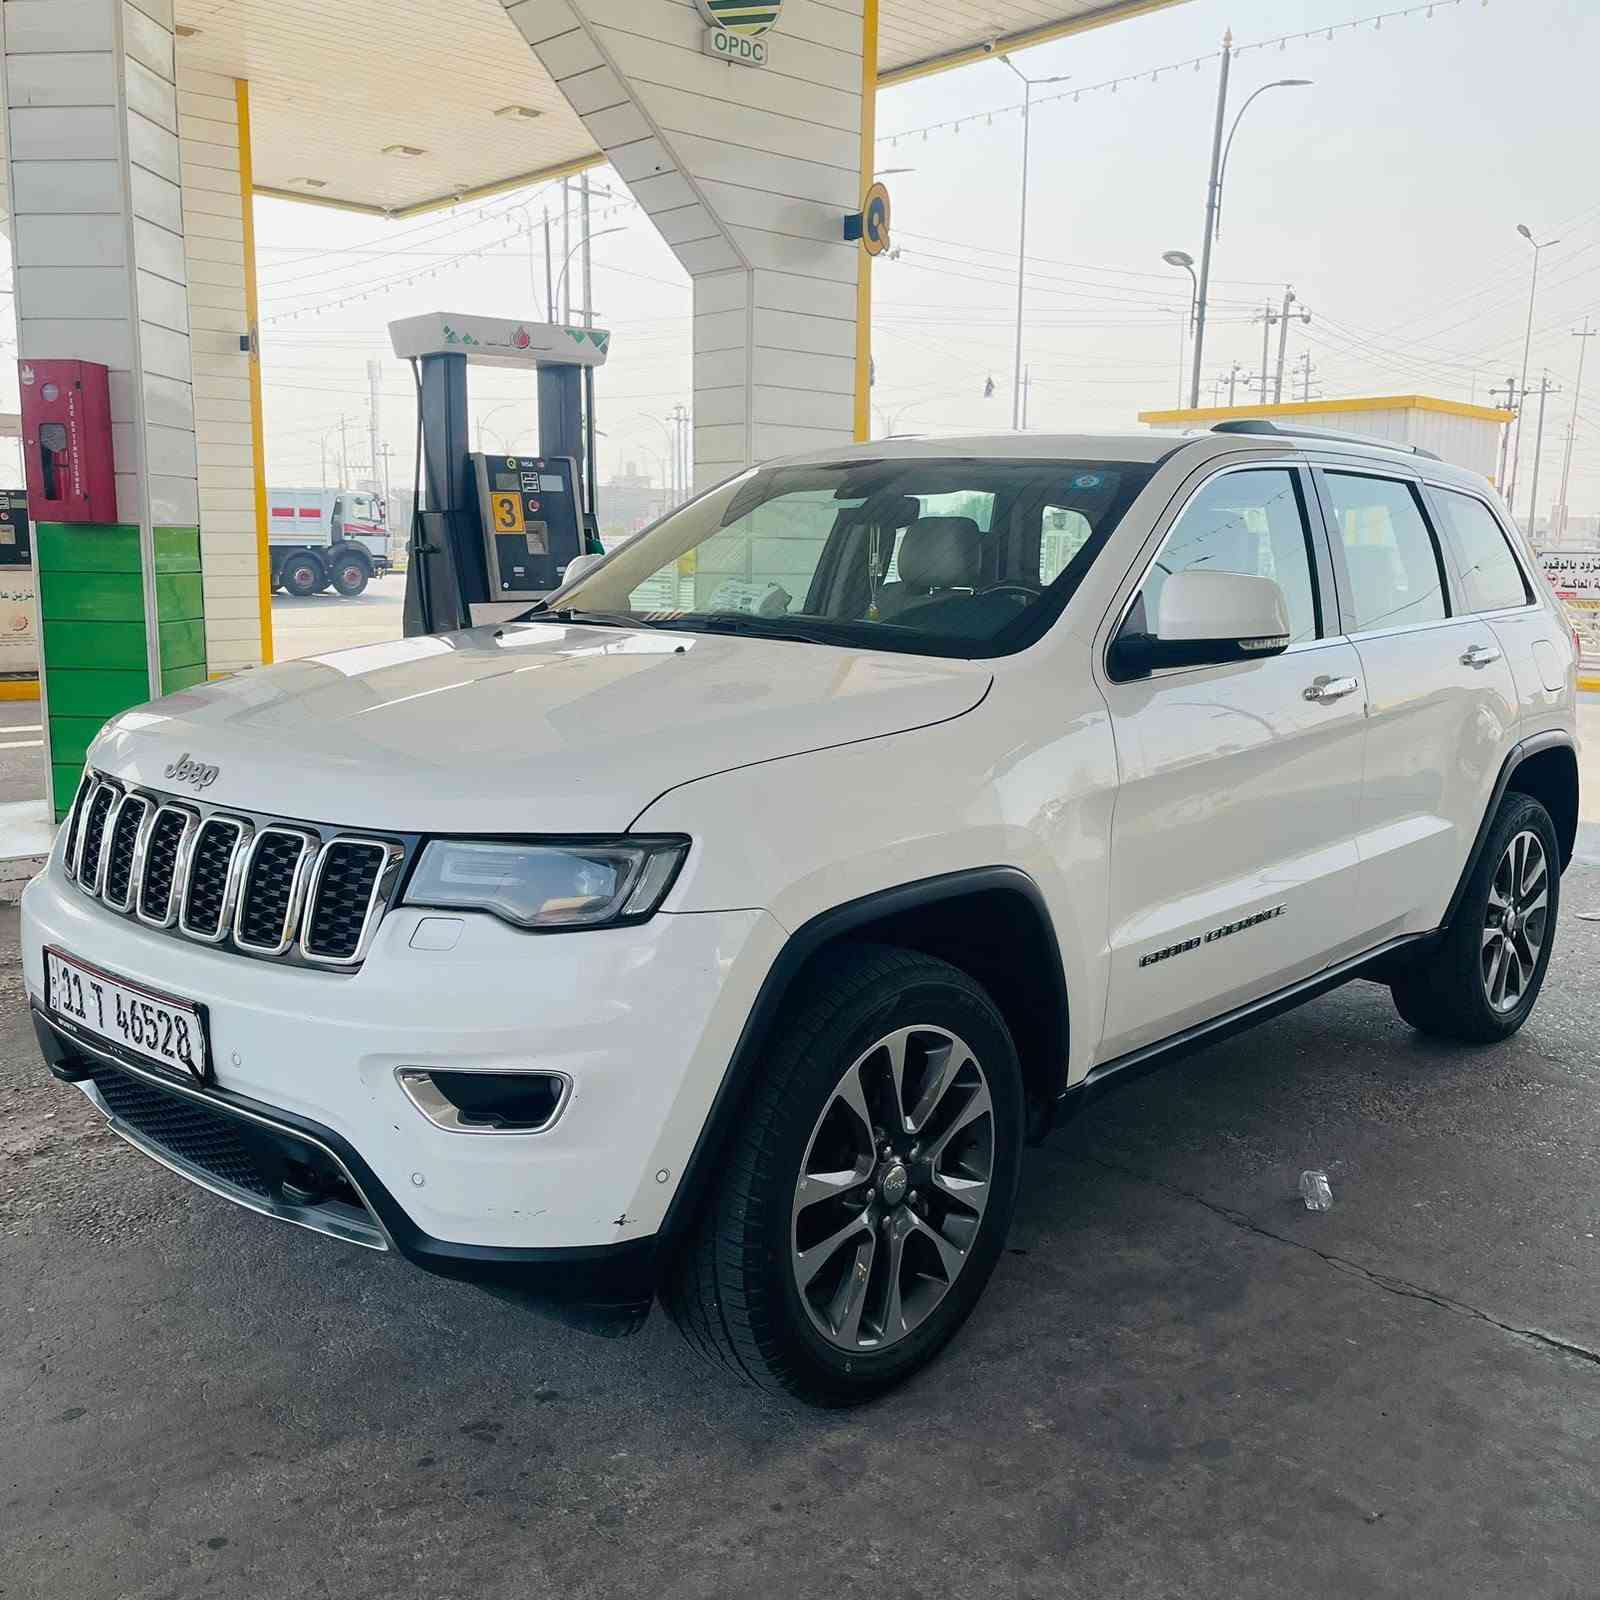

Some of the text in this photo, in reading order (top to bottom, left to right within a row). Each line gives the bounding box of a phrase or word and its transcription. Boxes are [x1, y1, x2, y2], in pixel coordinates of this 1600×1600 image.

[714, 32, 764, 61] OPDC
[499, 497, 516, 529] 3
[165, 752, 220, 792] Jeep
[62, 966, 86, 1019] 11
[90, 981, 104, 1029] T
[116, 992, 192, 1063] 46528
